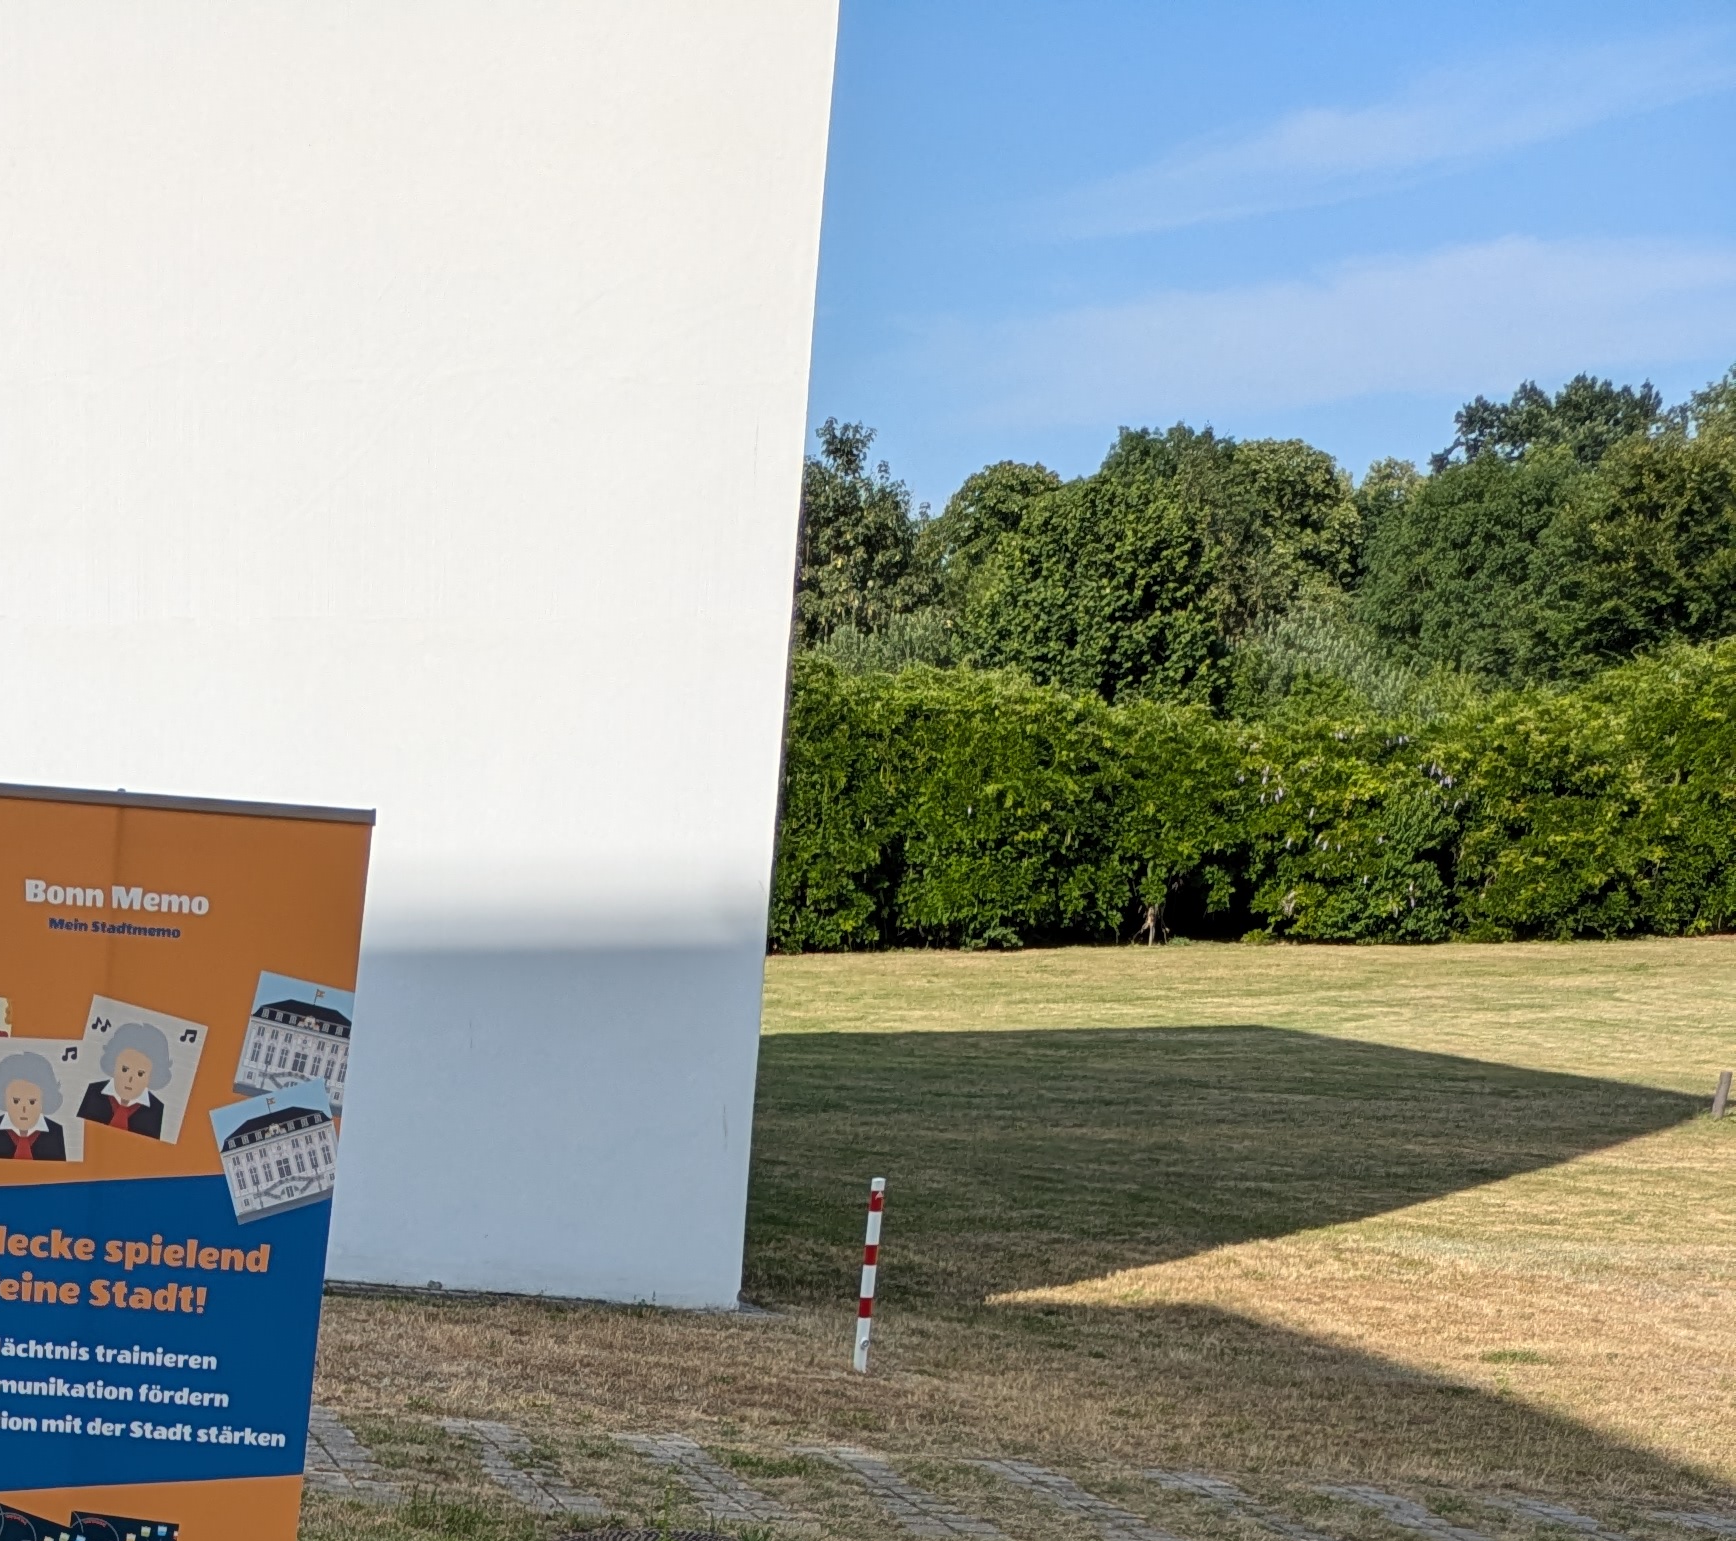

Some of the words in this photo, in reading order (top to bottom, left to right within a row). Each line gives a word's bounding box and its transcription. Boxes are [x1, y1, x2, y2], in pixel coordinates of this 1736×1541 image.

[24, 878, 105, 908] Bonn
[111, 885, 210, 915] Memo
[48, 917, 89, 932] Mein
[91, 921, 182, 938] Stadtmemo
[103, 1234, 271, 1273] spielend
[88, 1279, 208, 1314] Stadt!
[95, 1345, 217, 1370] trainieren
[139, 1384, 230, 1408] fördern
[41, 1414, 83, 1435] mit
[86, 1417, 126, 1437] der
[129, 1421, 193, 1442] Stadt
[196, 1425, 286, 1448] stärken
